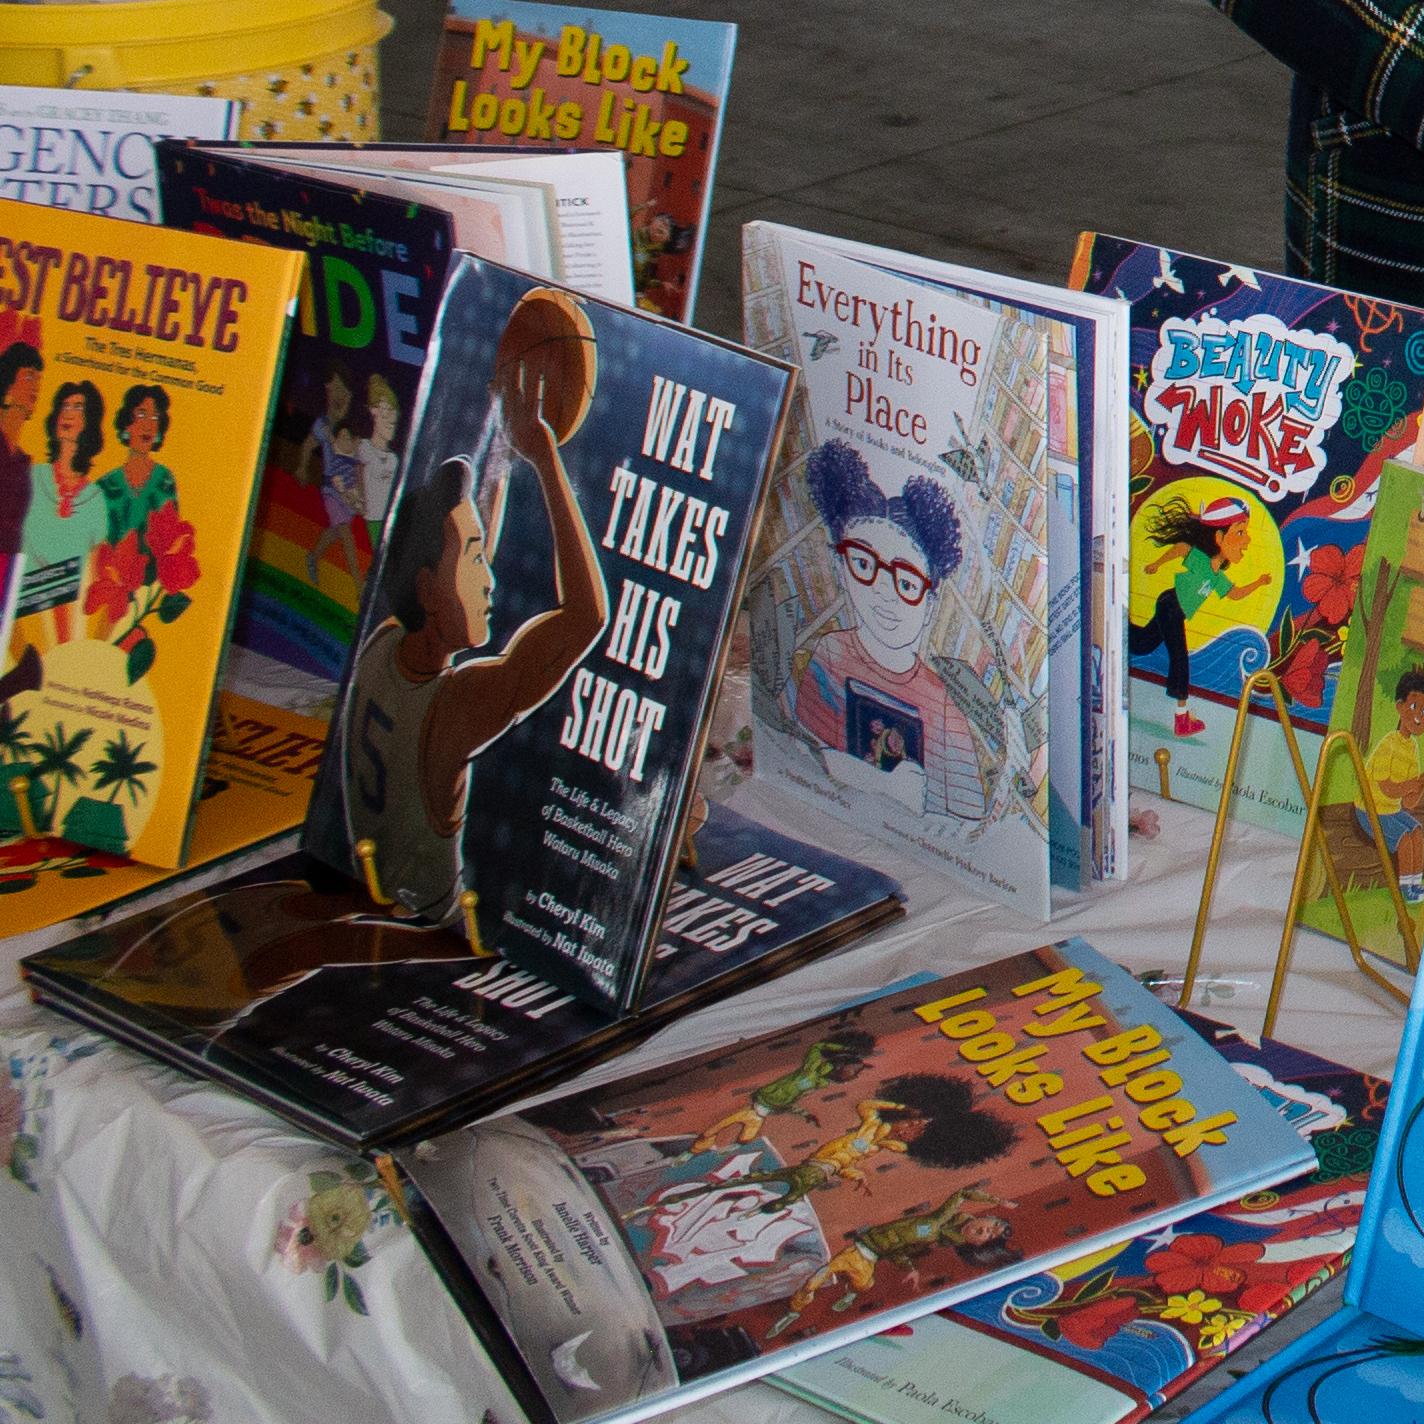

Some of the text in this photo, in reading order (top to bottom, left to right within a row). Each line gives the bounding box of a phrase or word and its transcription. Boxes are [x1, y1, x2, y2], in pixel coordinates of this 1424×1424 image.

[471, 19, 545, 89] My
[449, 80, 689, 158] Looks Like
[246, 202, 409, 262] the Night Before
[58, 252, 248, 353] BELIEVE
[797, 260, 981, 386] Everything
[195, 380, 225, 396] Good
[858, 342, 914, 387] in Its
[1165, 328, 1341, 421] BEAUTY
[642, 375, 736, 480] WAT
[845, 371, 928, 445] Place
[1156, 381, 1315, 478] WOKE
[602, 467, 730, 590] TAKES
[606, 578, 681, 680] HIS
[560, 667, 667, 782] SHOT
[550, 776, 638, 833] The Life Legacy
[1175, 765, 1306, 816] Illustrated Escobar
[552, 807, 633, 857] Basketball Hero
[580, 849, 619, 880] Misaka
[704, 852, 836, 908] WAT
[525, 889, 606, 939] by Cheryl Kim
[551, 931, 615, 977] Nat Iwata
[1012, 967, 1108, 1038] My
[322, 1068, 396, 1108] Nat Iwata
[326, 1045, 378, 1072] Cheryl
[370, 1062, 406, 1085] Kim
[912, 986, 1064, 1105] Looks
[1036, 1095, 1147, 1197] Like
[487, 1213, 540, 1287] Frank Morrison
[552, 1201, 604, 1266] Janelle Harper
[543, 1265, 583, 1316] Award Winner
[834, 1355, 941, 1409] Illustrated Paola
